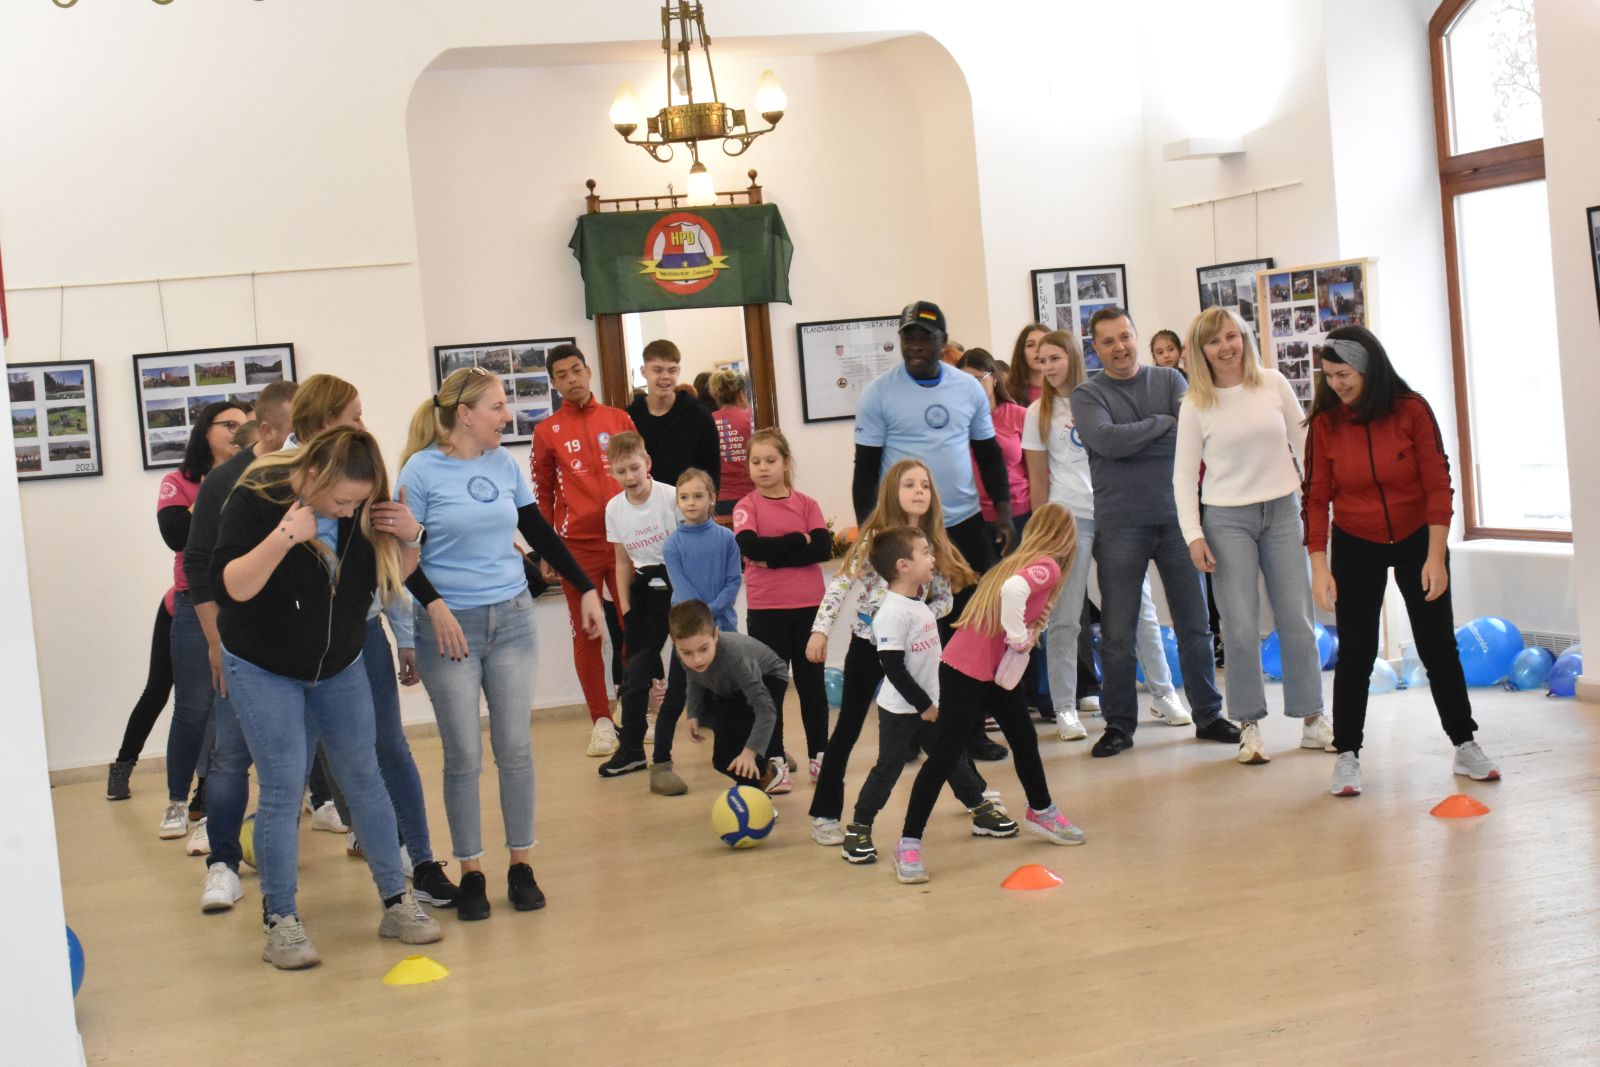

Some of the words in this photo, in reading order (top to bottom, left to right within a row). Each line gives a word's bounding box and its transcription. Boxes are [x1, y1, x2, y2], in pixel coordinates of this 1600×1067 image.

[671, 231, 695, 245] HPD
[564, 439, 581, 453] 19
[75, 463, 95, 472] 2023
